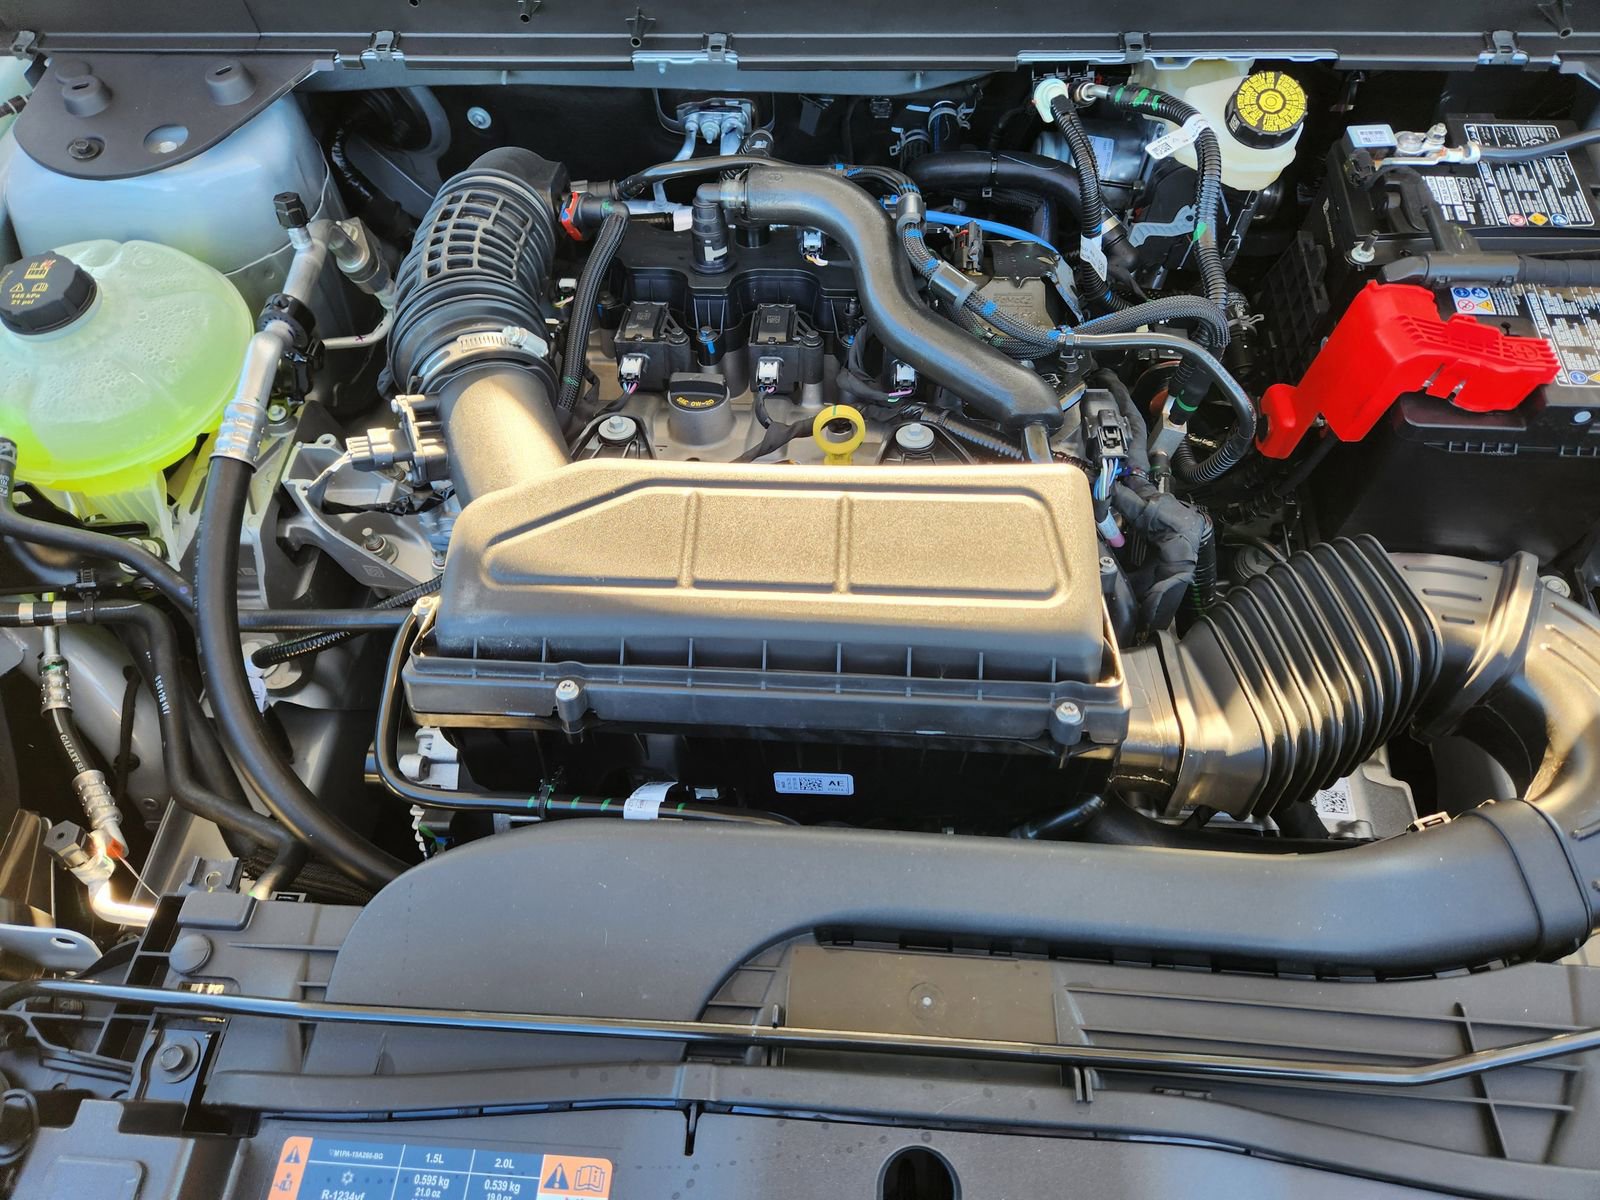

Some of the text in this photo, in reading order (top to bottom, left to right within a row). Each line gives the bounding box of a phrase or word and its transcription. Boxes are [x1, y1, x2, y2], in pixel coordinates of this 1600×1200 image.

[676, 397, 715, 407] SAE 0W-20
[60, 734, 81, 762] GALAXY
[425, 1152, 445, 1163] 1.5L
[494, 1158, 515, 1169] 2.0L
[414, 1174, 521, 1194] 0.595 kg 0.539 kg
[415, 1187, 431, 1197] 21.0
[432, 1189, 442, 1198] oz
[486, 1192, 502, 1200] 19.0
